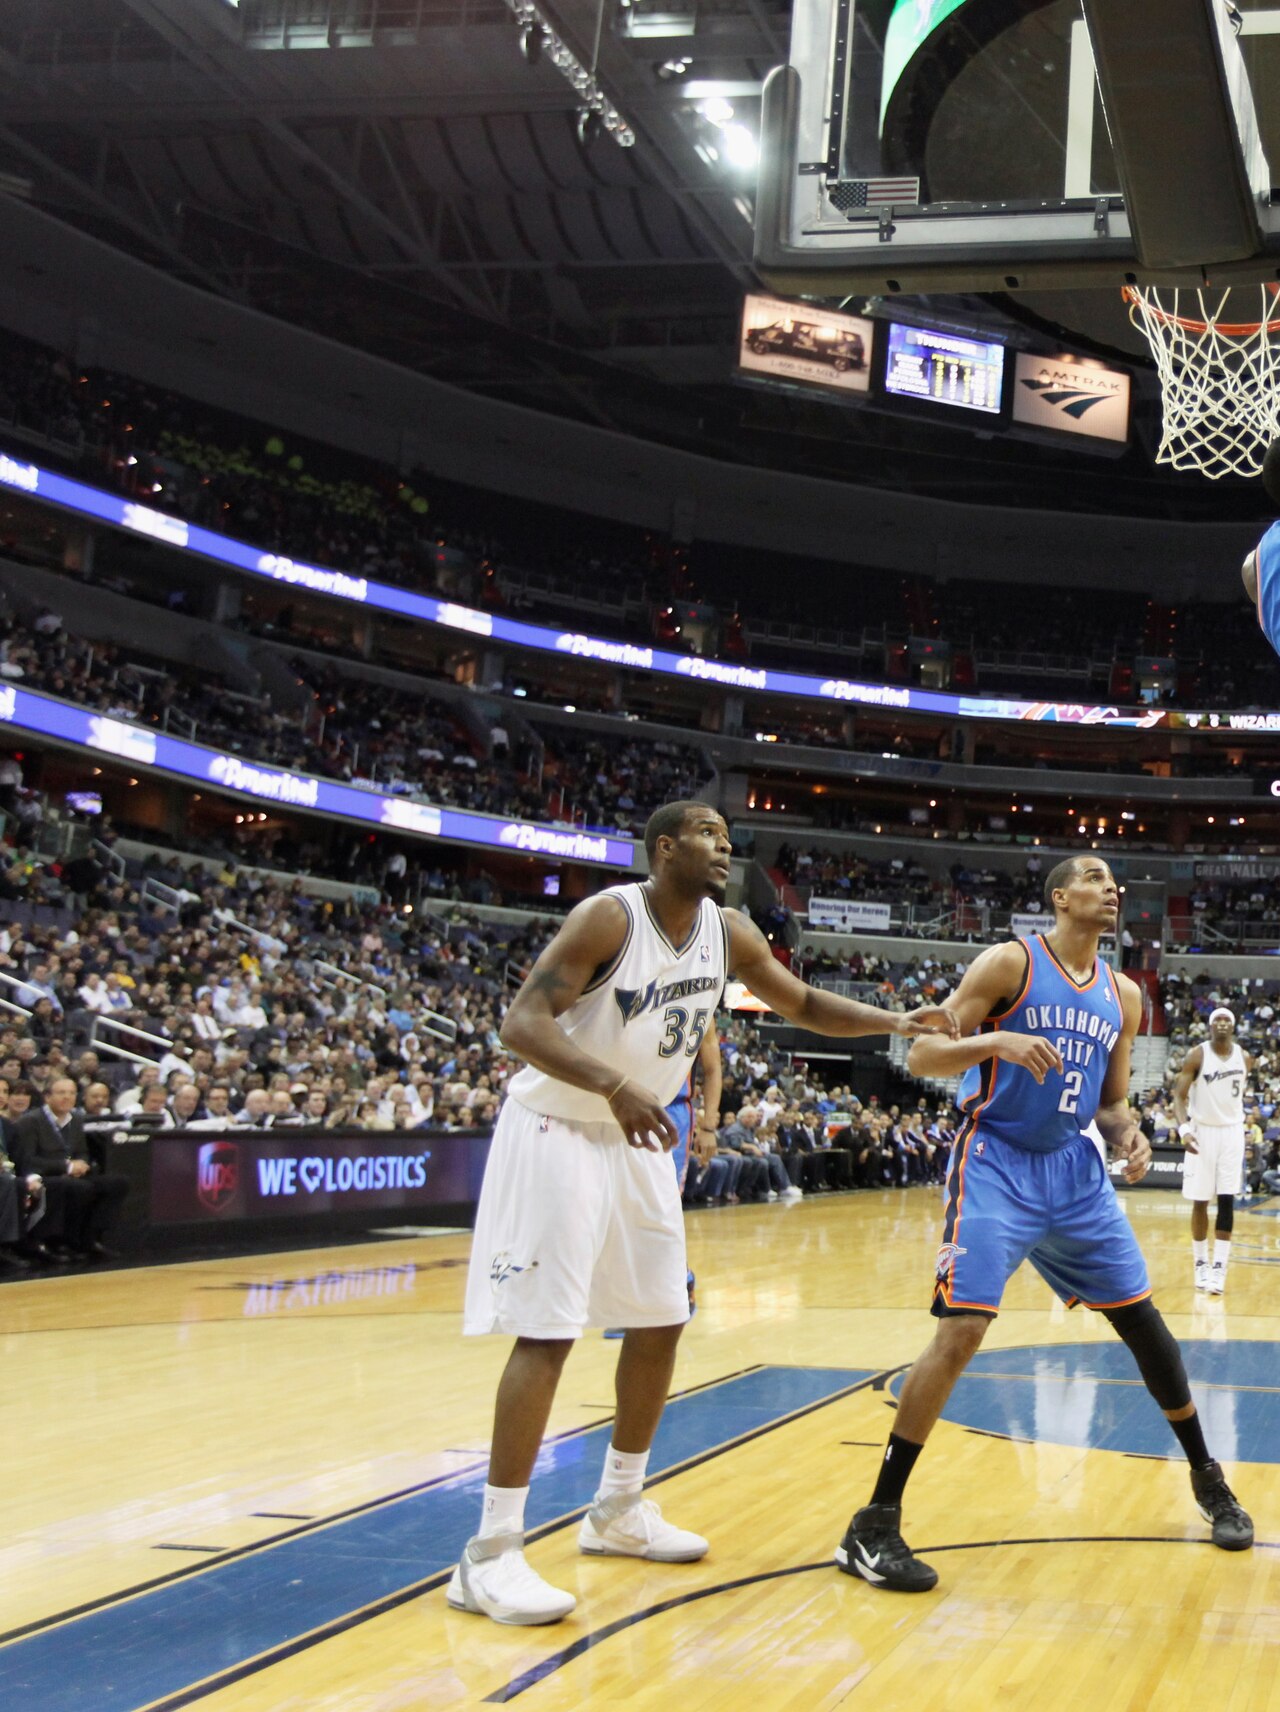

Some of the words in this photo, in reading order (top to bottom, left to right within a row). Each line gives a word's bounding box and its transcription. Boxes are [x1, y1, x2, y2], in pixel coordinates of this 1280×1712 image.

[1038, 367, 1121, 393] AMTRAK
[1195, 864, 1227, 876] GREAT
[1228, 863, 1266, 878] WALL
[811, 902, 847, 913] Honoring
[847, 905, 860, 913] Our
[862, 907, 889, 916] Heroes
[659, 1006, 710, 1058] 35
[1025, 1005, 1119, 1052] OKLAHOMA
[1056, 1036, 1095, 1067] CITY
[1057, 1070, 1083, 1115] 2
[1231, 1079, 1241, 1098] 5
[202, 1163, 235, 1200] ups
[258, 1158, 298, 1197] WE
[325, 1155, 427, 1193] LOGISTICS
[1153, 1161, 1176, 1172] YOUR
